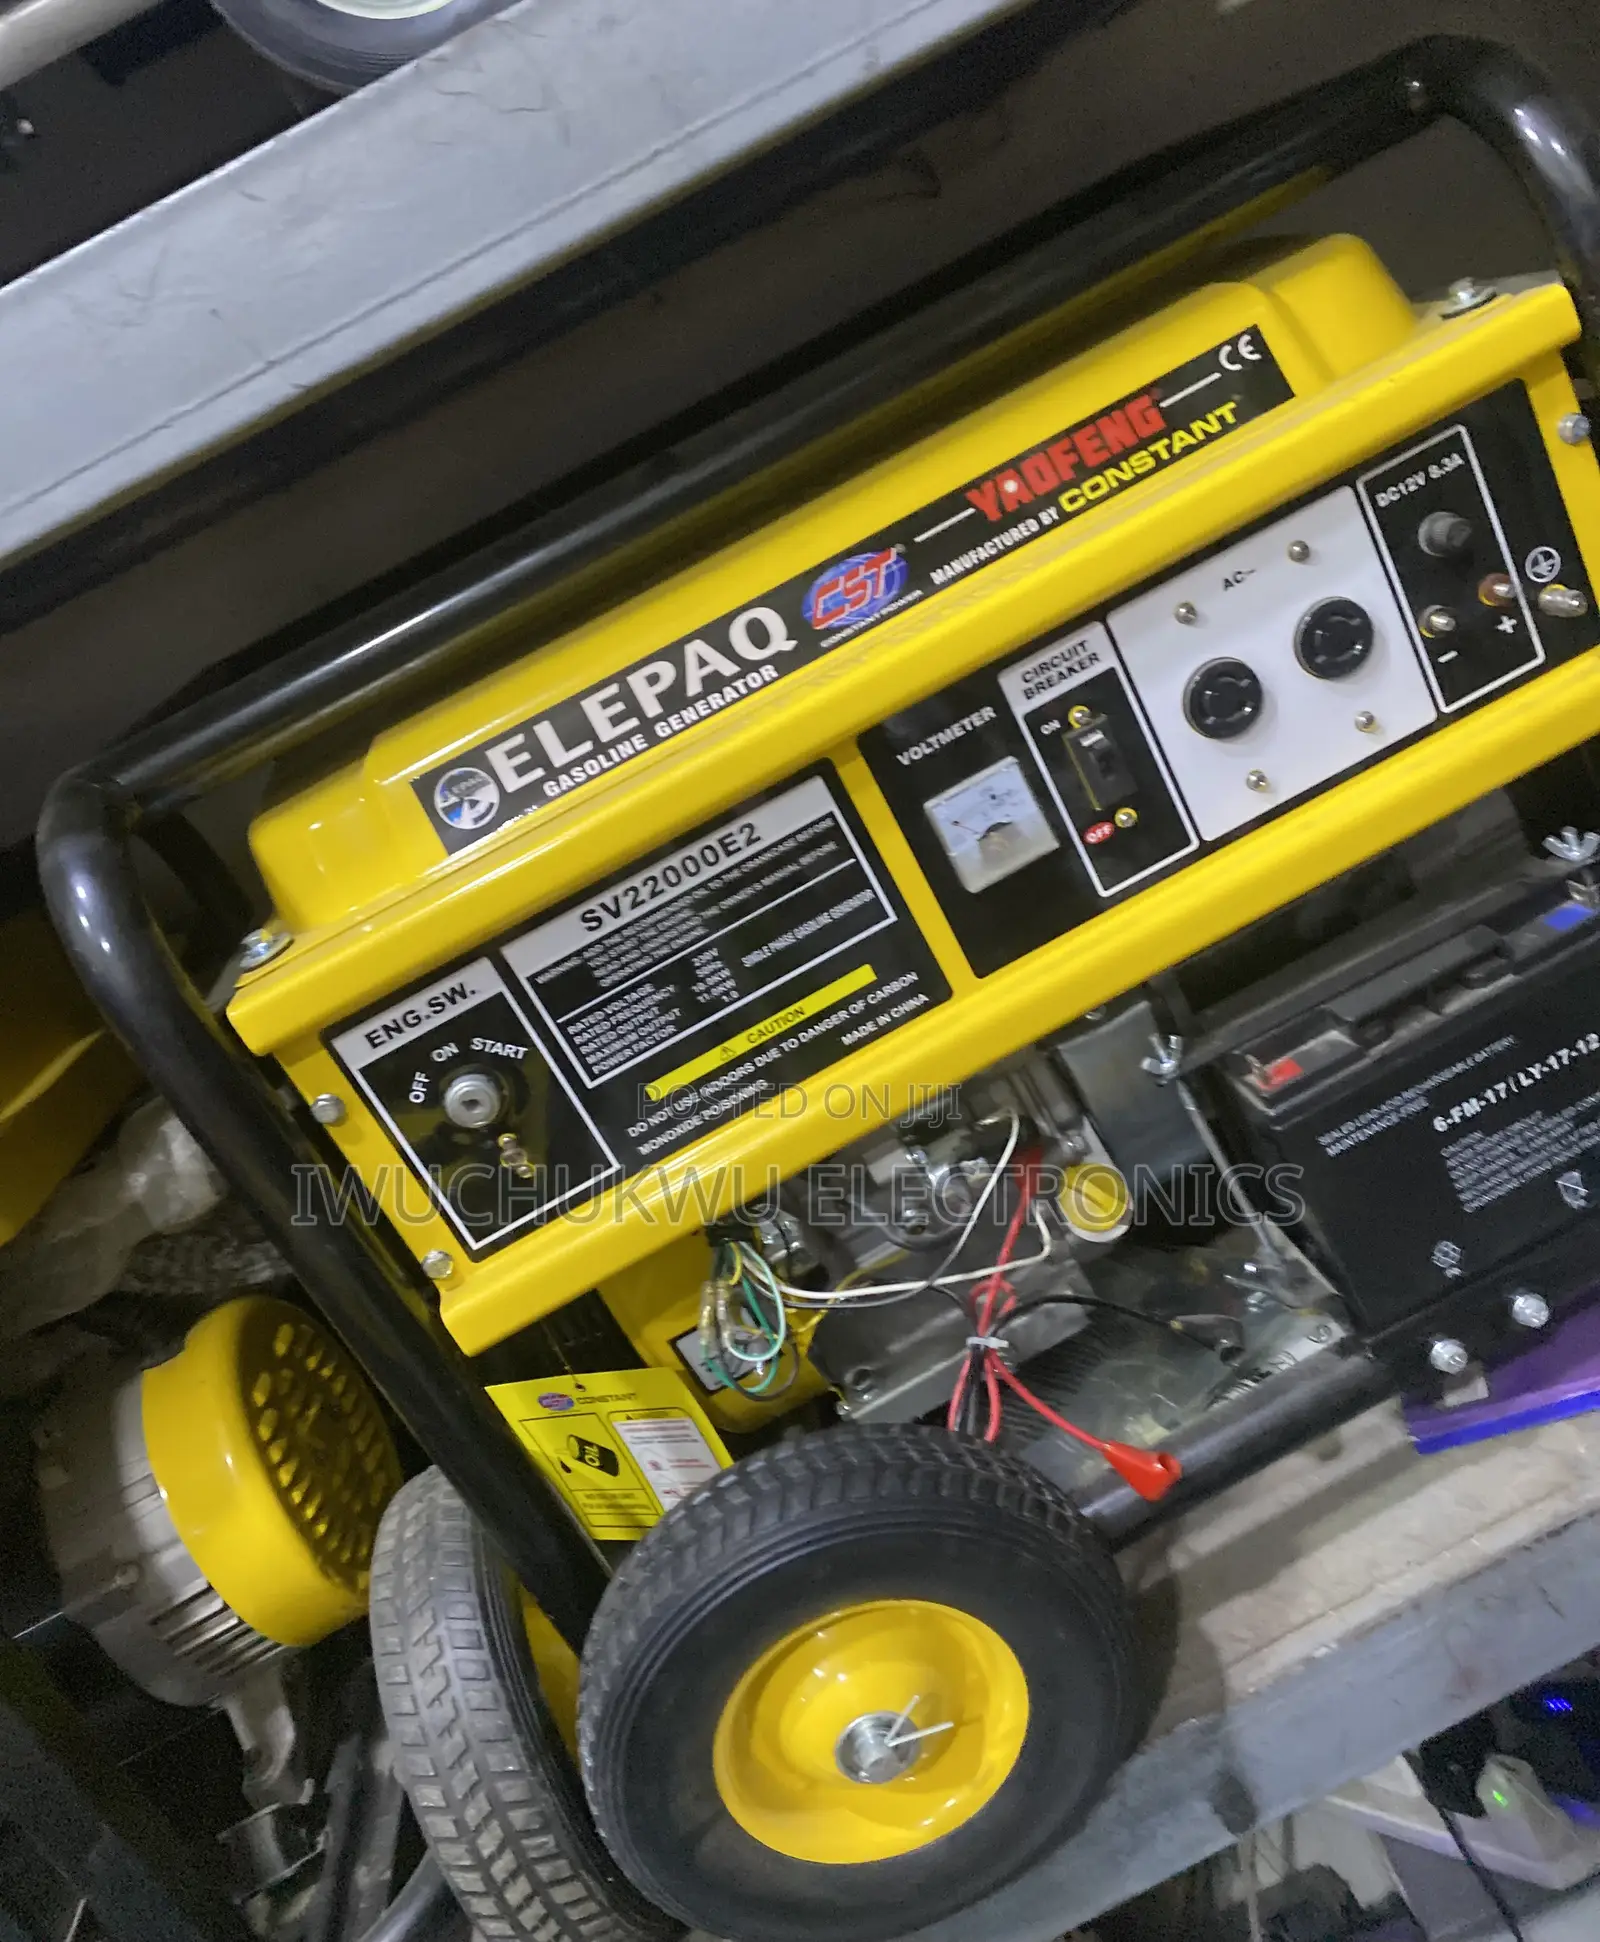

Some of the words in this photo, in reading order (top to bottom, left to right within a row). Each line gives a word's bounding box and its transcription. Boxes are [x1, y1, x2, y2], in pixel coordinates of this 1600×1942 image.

[965, 394, 1167, 522] YAOFENG
[930, 518, 1041, 585] MANUFACTURED
[1039, 506, 1060, 526] BY
[1058, 402, 1237, 513] CONSTANT
[1375, 471, 1425, 507] DC12V
[812, 547, 897, 629] CST
[1022, 640, 1088, 684] CIRCUIT
[1023, 653, 1102, 700] BREAKER
[485, 607, 798, 793] ELEPAQ
[1040, 719, 1061, 735] ON
[543, 734, 648, 797] GASOLINE
[655, 664, 779, 738] GENERATOR
[896, 706, 997, 766] VOLTMETER
[1086, 824, 1112, 842] OFF
[580, 823, 761, 932] SV22000E2
[365, 982, 476, 1049] ENG.SW.
[566, 1008, 606, 1036] RATED
[602, 981, 655, 1016] VOLTAGE
[572, 1018, 612, 1045] RATED
[608, 982, 677, 1026] FREQUENCY
[579, 1028, 618, 1055] RATED
[614, 1004, 661, 1036] OUTPUT
[585, 1030, 639, 1065] MAXIMUM
[636, 1005, 683, 1037] OUTPUT
[747, 1006, 805, 1044] CAUTION
[840, 1019, 878, 1047] MADE
[874, 1011, 892, 1027] IN
[888, 990, 929, 1019] CHINA
[430, 1042, 459, 1062] ON
[470, 1037, 528, 1059] START
[591, 1046, 634, 1075] POWER
[631, 1022, 677, 1053] FACTOR
[626, 1119, 648, 1139] DO
[647, 1105, 674, 1127] NOT
[673, 1090, 700, 1113] USE
[753, 1046, 782, 1068] DUE
[779, 1036, 800, 1054] TO
[797, 1008, 851, 1043] DANGER
[847, 998, 868, 1015] OF
[864, 970, 920, 1005] CARBON
[409, 1072, 430, 1103] OFF
[638, 1113, 703, 1157] MONOXIDE
[700, 1077, 768, 1122] POISONING
[584, 1445, 601, 1467] OIL
